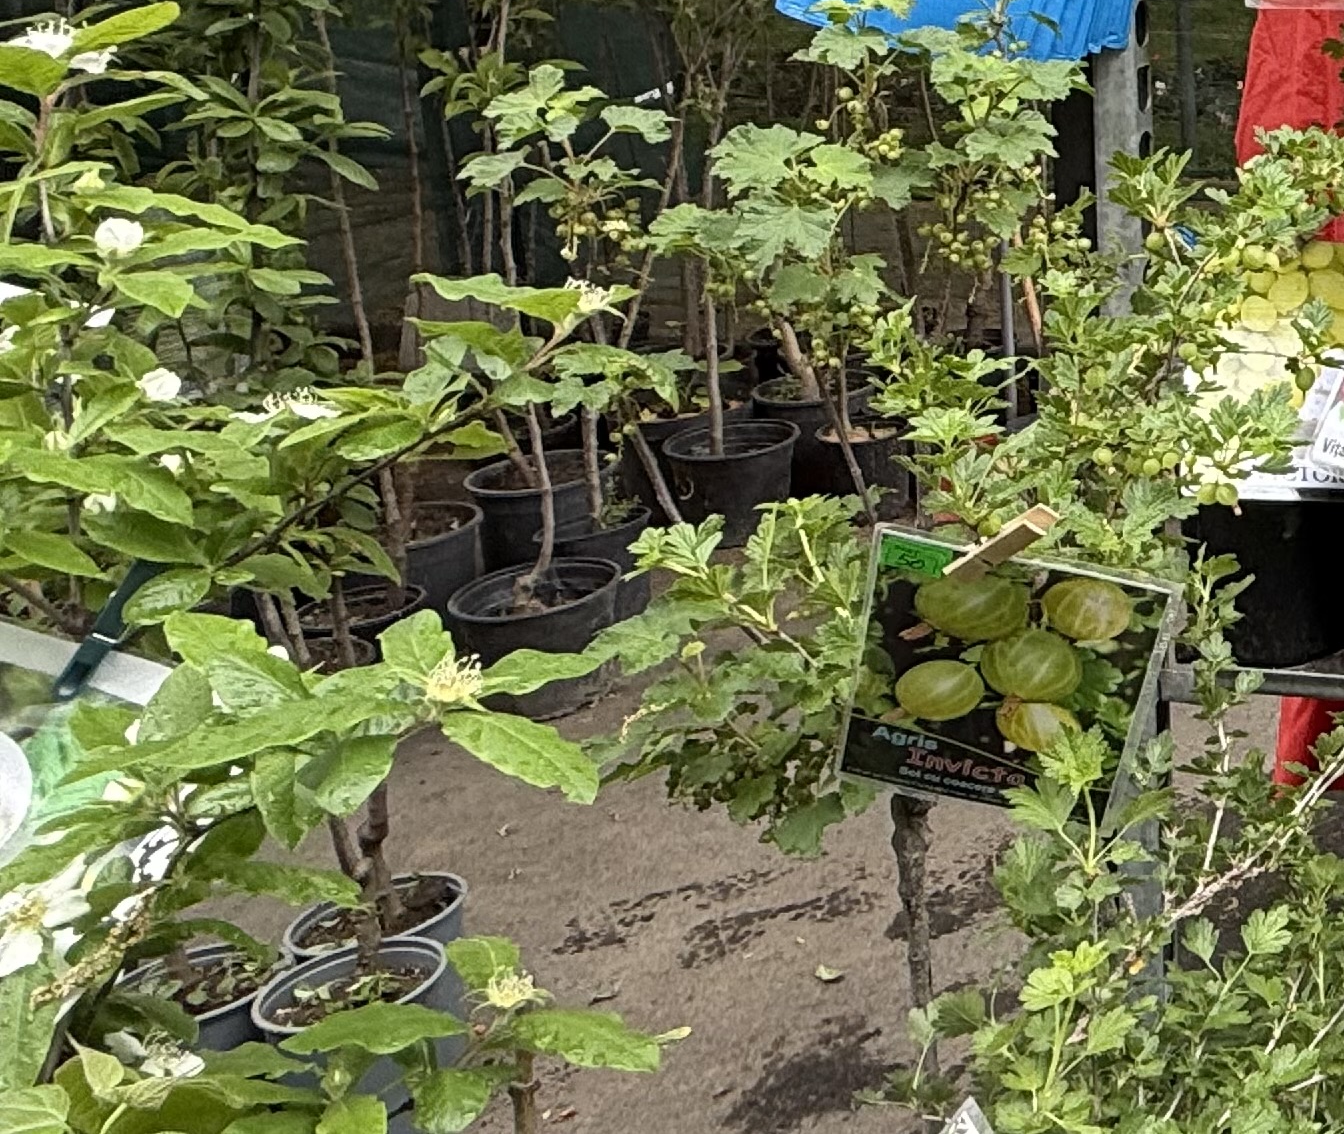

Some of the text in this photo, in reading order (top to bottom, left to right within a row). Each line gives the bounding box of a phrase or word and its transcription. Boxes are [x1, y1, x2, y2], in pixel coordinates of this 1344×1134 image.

[897, 553, 926, 569] 50
[872, 726, 938, 751] Agris
[906, 746, 1026, 786] Invicta
